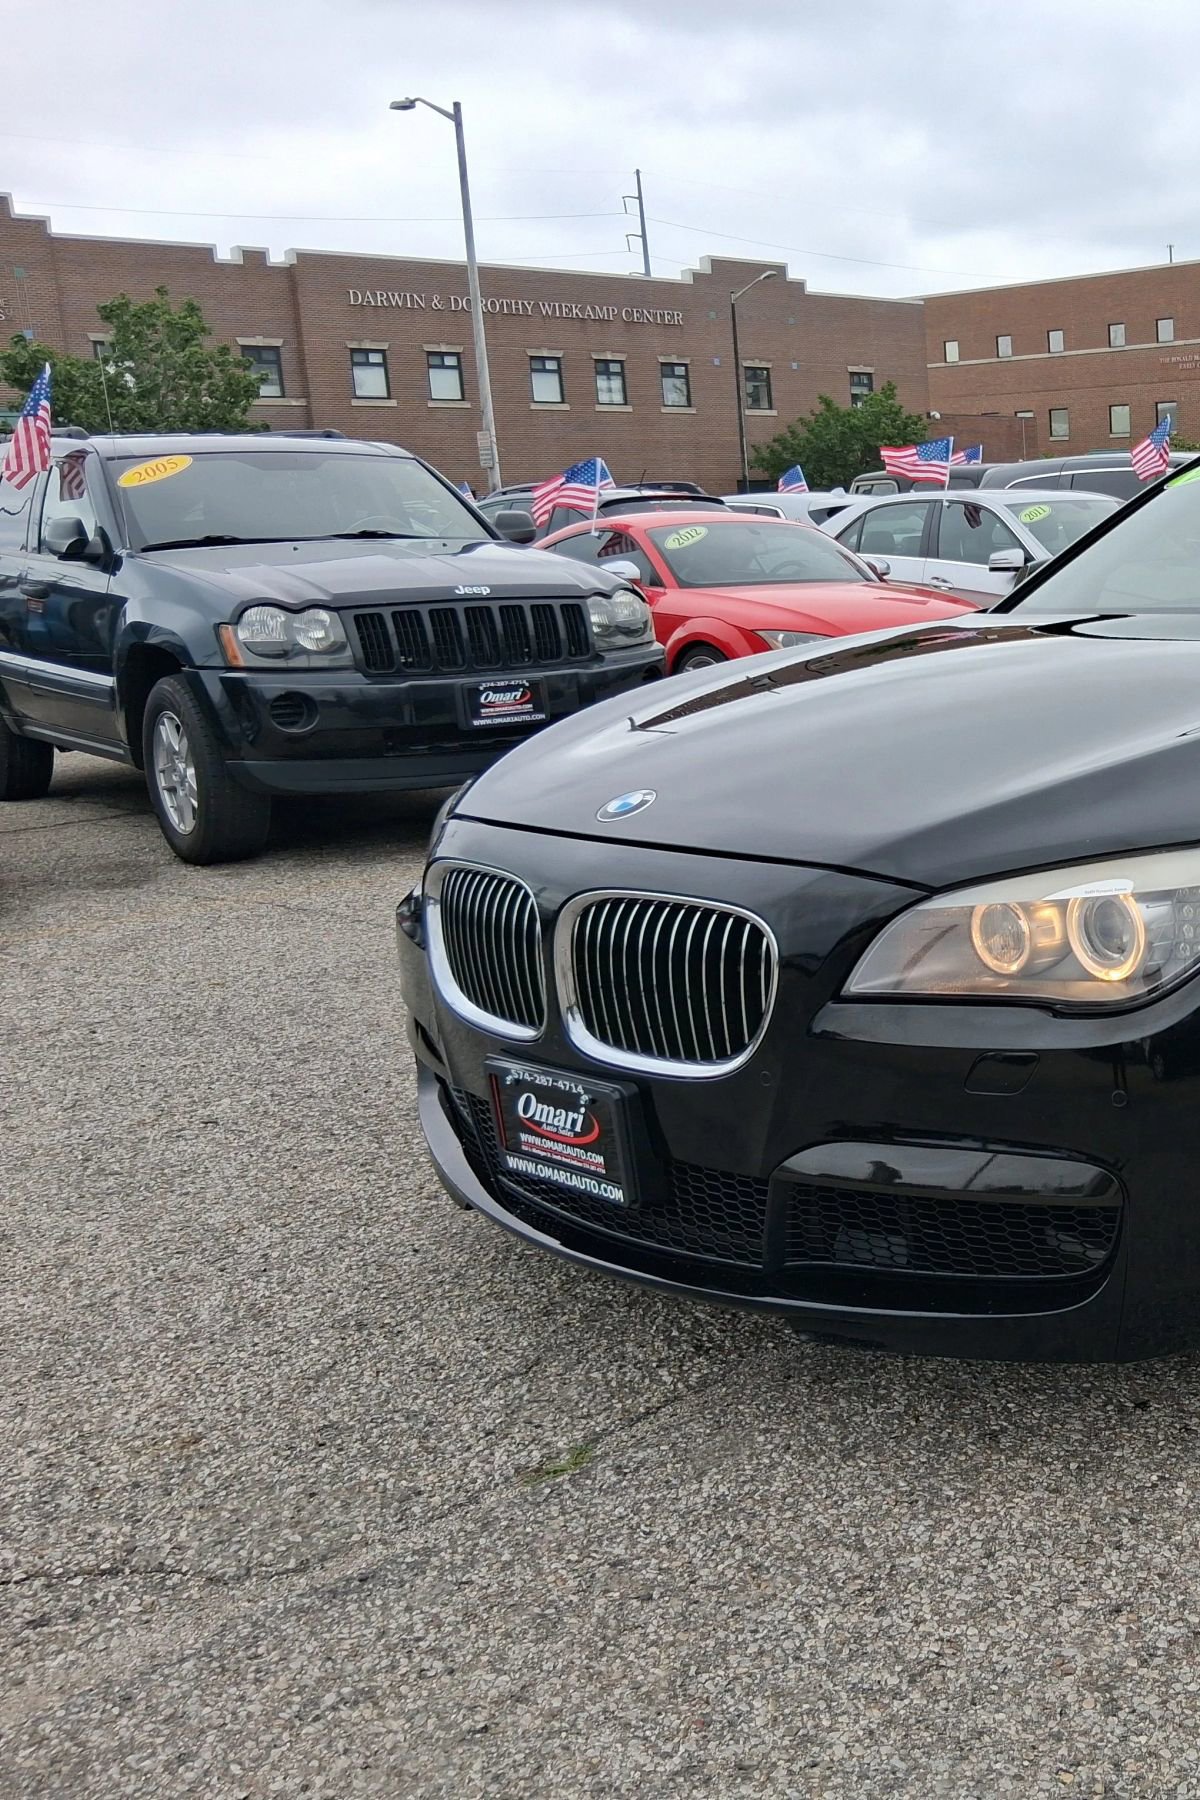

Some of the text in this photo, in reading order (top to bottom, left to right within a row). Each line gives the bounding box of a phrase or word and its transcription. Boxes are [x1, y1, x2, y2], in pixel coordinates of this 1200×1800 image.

[348, 289, 426, 310] DARWIN
[431, 294, 445, 310] &
[538, 301, 618, 321] WIEKAMP
[621, 307, 684, 325] CENTER
[132, 458, 178, 482] 2005
[1024, 506, 1047, 521] 2011
[672, 528, 702, 546] 2012
[454, 584, 491, 596] Jeep
[480, 688, 523, 704] Omari
[510, 1069, 584, 1095] 574-287-4714
[517, 1092, 585, 1133] Omari
[541, 1122, 557, 1133] Auto
[520, 1132, 605, 1166] WWW.OMARIAUTO.COM
[506, 1155, 624, 1202] WWW.OMARIAUTO.COM
